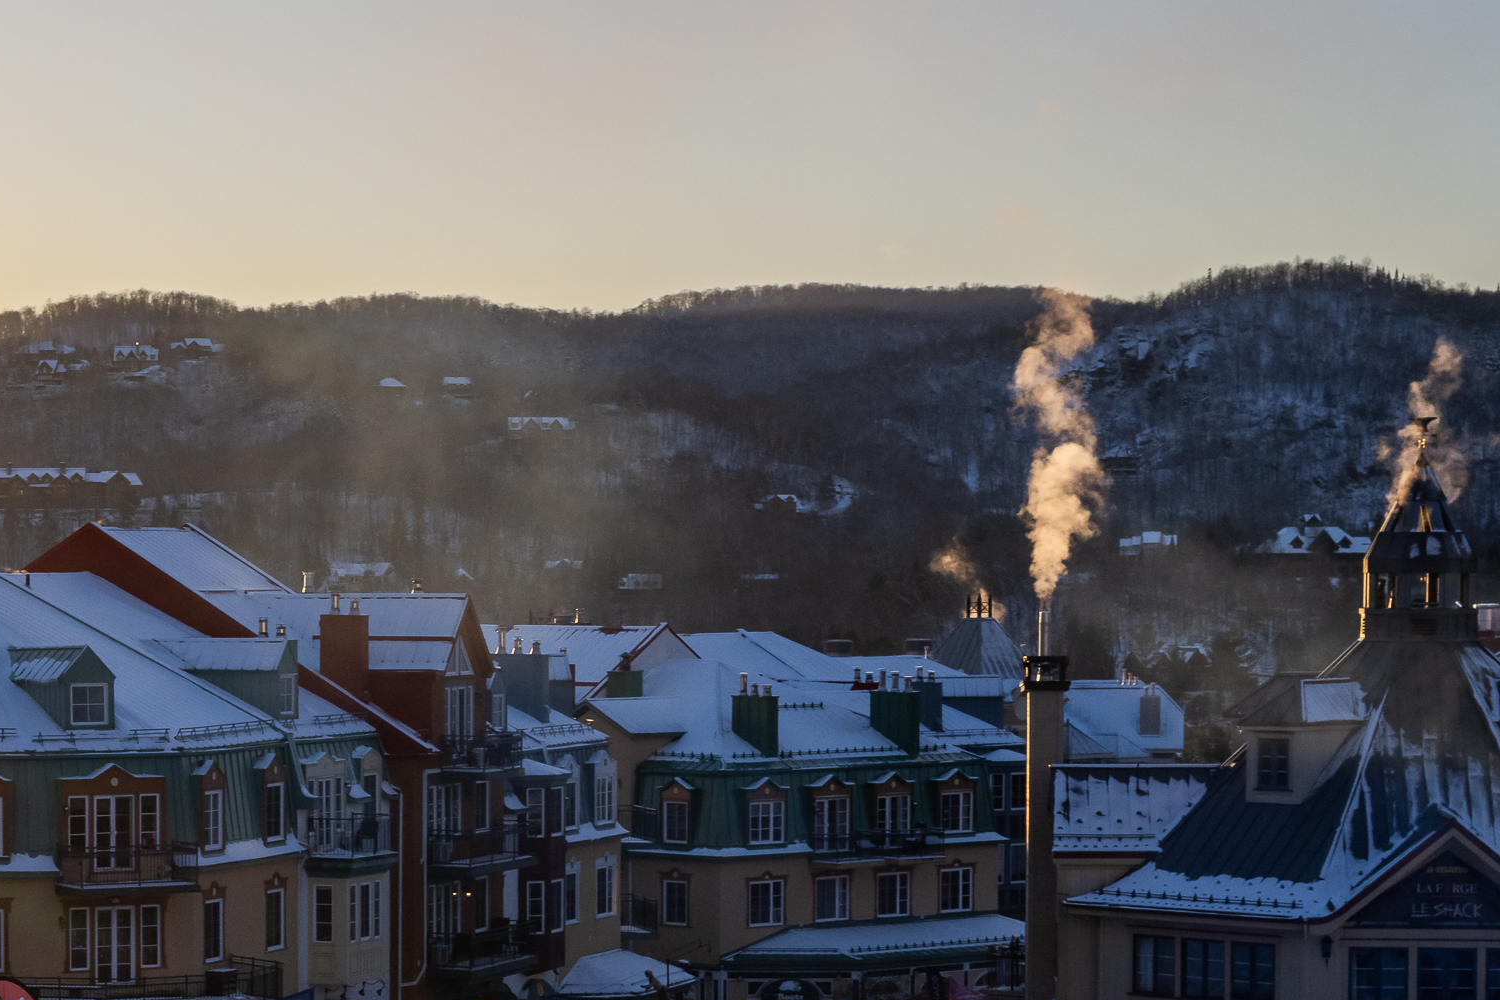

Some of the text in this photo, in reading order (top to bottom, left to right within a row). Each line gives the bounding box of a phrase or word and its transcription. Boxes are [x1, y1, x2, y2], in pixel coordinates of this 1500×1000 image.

[1411, 902, 1483, 918] LE SHACK
[777, 993, 804, 1000] Roots
